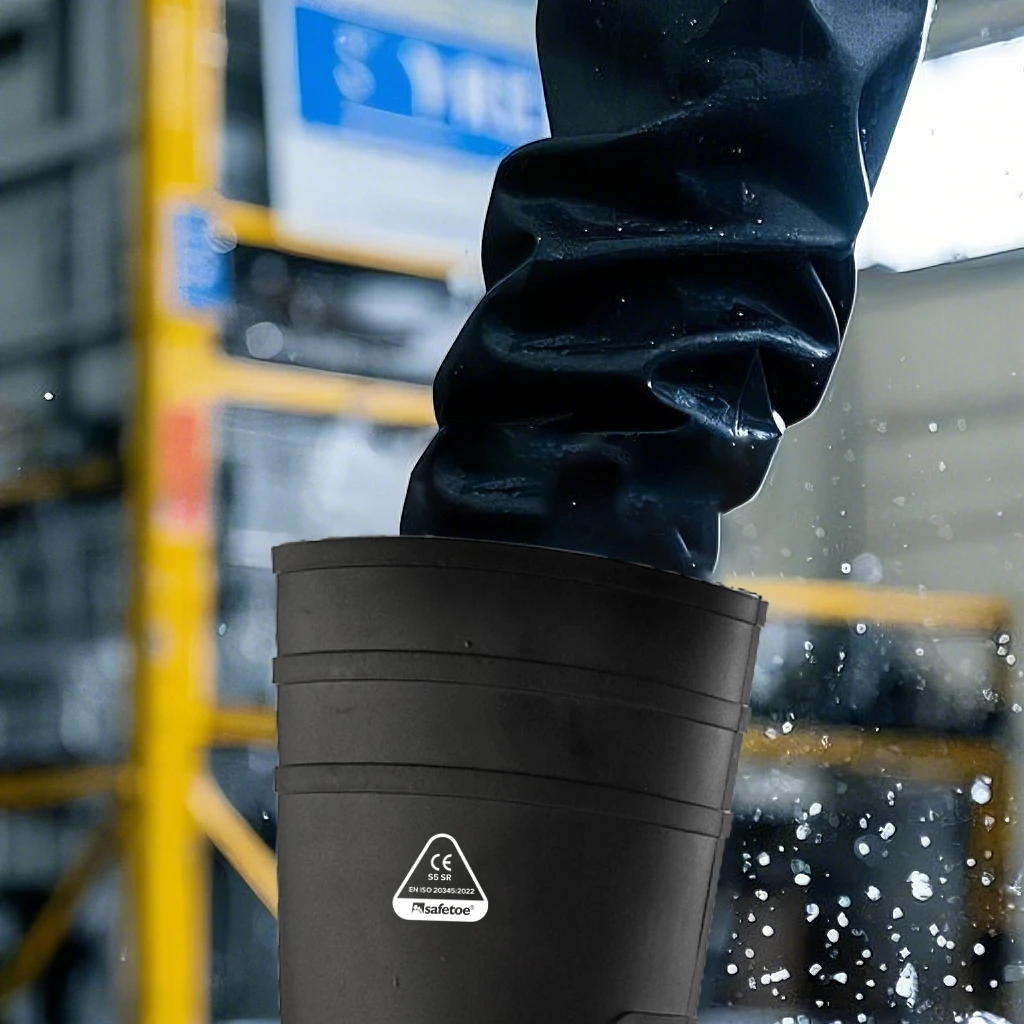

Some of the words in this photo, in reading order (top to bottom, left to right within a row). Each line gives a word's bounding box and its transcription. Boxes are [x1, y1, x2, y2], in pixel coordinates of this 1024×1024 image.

[427, 873, 439, 881] S5
[440, 873, 452, 881] SR
[419, 886, 433, 894] ISO
[433, 887, 475, 895] 20345:2022
